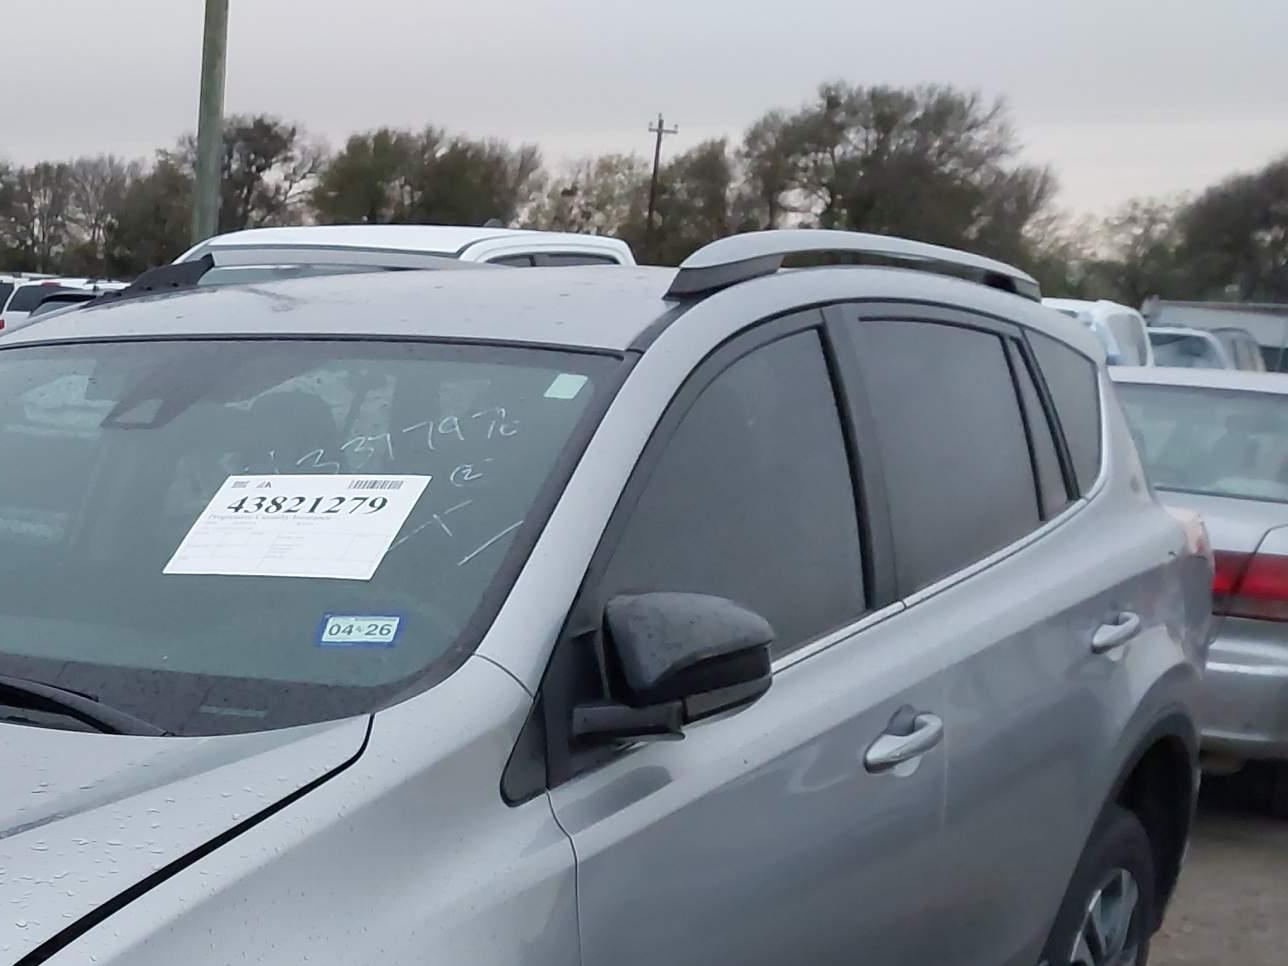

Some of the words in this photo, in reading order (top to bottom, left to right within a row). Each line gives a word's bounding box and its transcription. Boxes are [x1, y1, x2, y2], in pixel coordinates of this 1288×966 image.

[226, 496, 390, 514] 43821279
[328, 623, 354, 636] 04
[364, 623, 393, 636] 26
